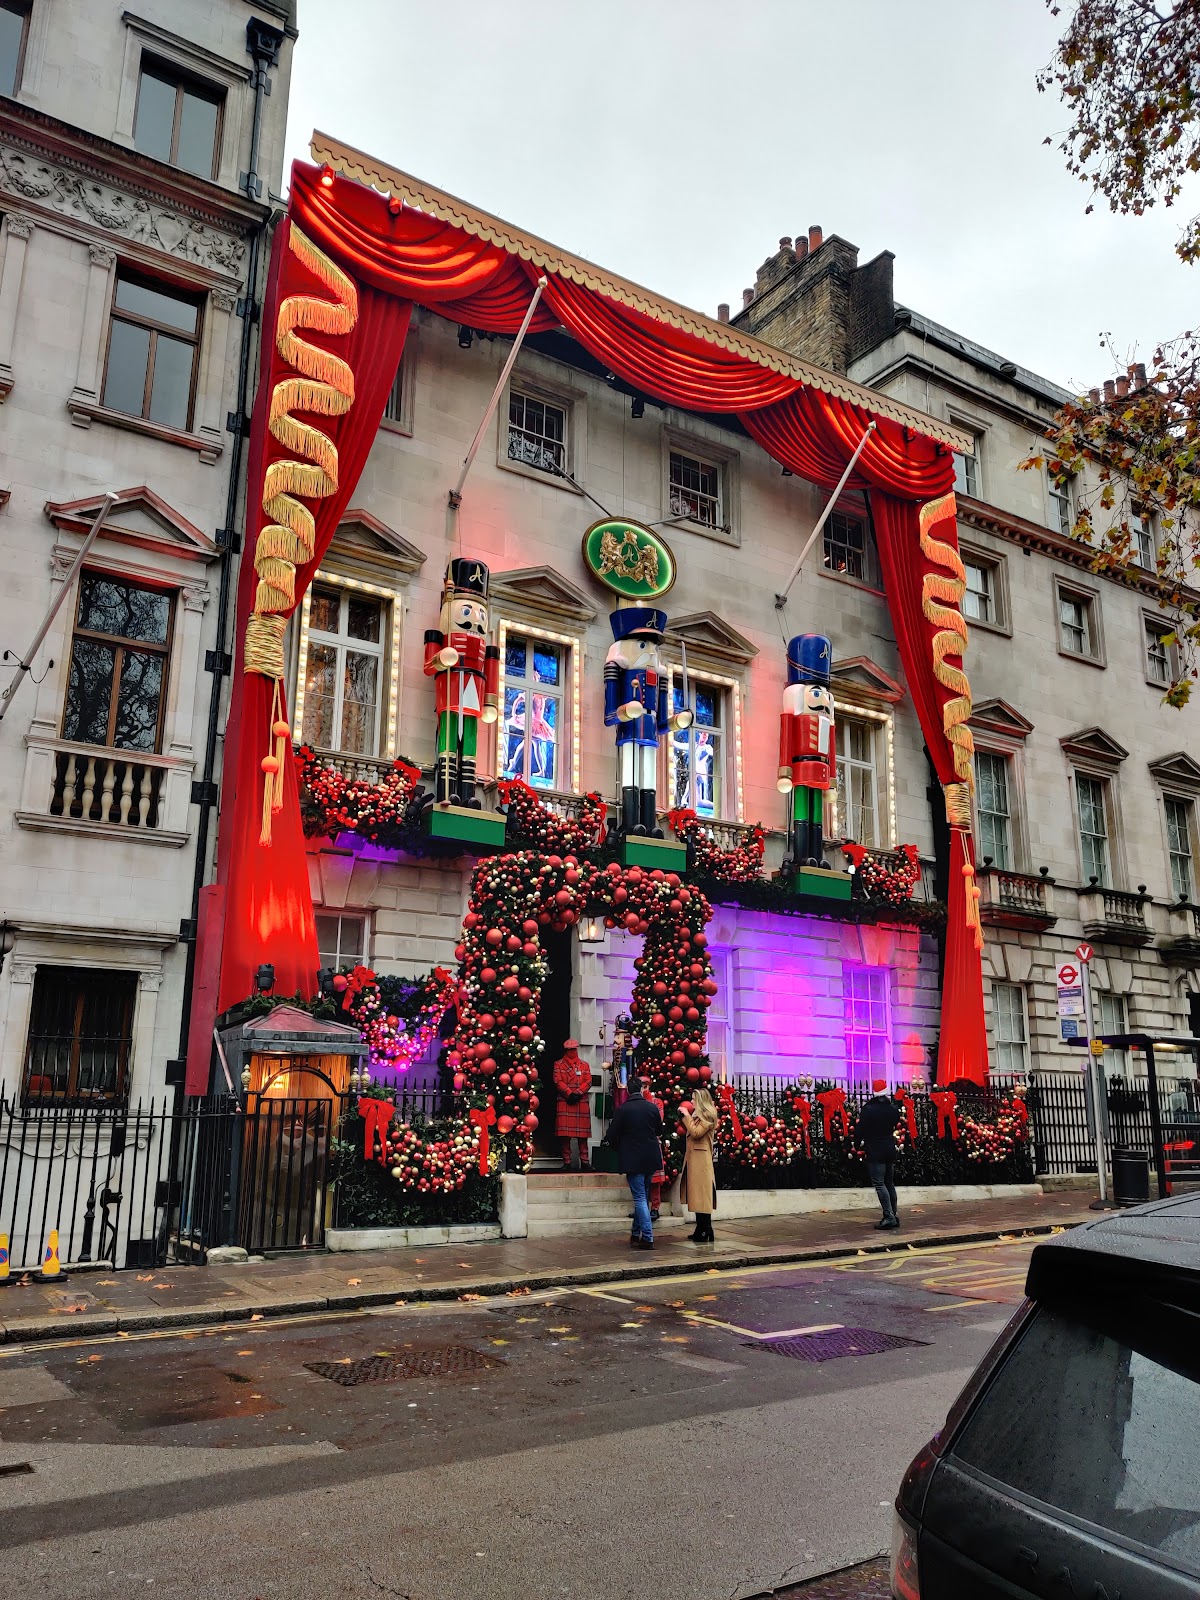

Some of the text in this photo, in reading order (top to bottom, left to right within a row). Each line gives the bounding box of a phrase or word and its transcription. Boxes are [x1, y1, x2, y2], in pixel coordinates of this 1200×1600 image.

[469, 564, 485, 585] A
[646, 610, 659, 629] A
[819, 643, 830, 660] A
[1078, 946, 1090, 960] V
